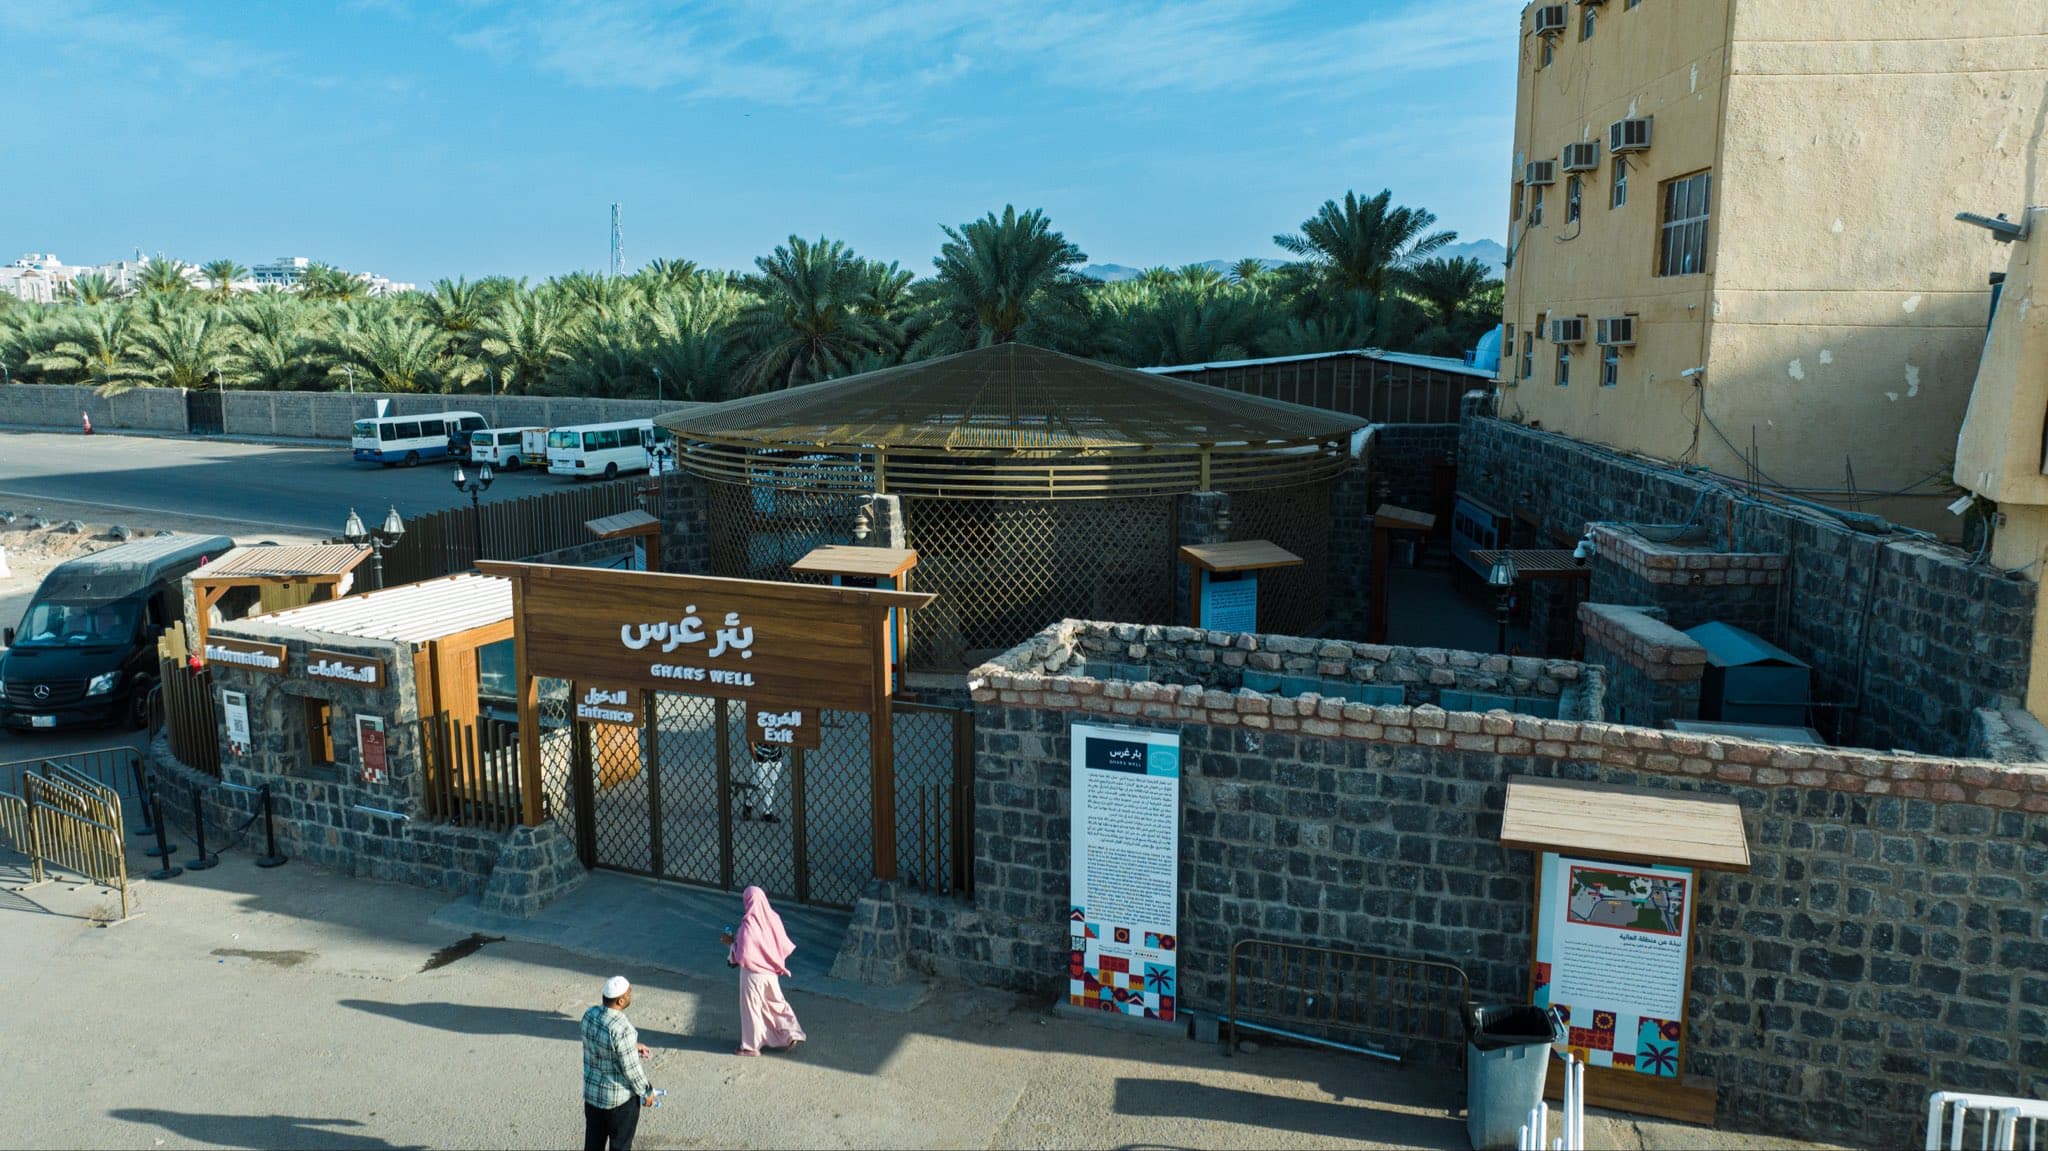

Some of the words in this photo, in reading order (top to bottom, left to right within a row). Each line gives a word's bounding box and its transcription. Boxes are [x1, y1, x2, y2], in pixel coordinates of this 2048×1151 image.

[620, 604, 706, 654] غرس
[709, 611, 755, 660] بئر
[205, 645, 279, 669] Information
[650, 664, 705, 682] GHARS
[710, 669, 755, 687] WELL
[584, 687, 628, 706] الدخول
[576, 703, 634, 723] Entrance
[757, 710, 802, 728] الخروج
[764, 726, 793, 744] Exit
